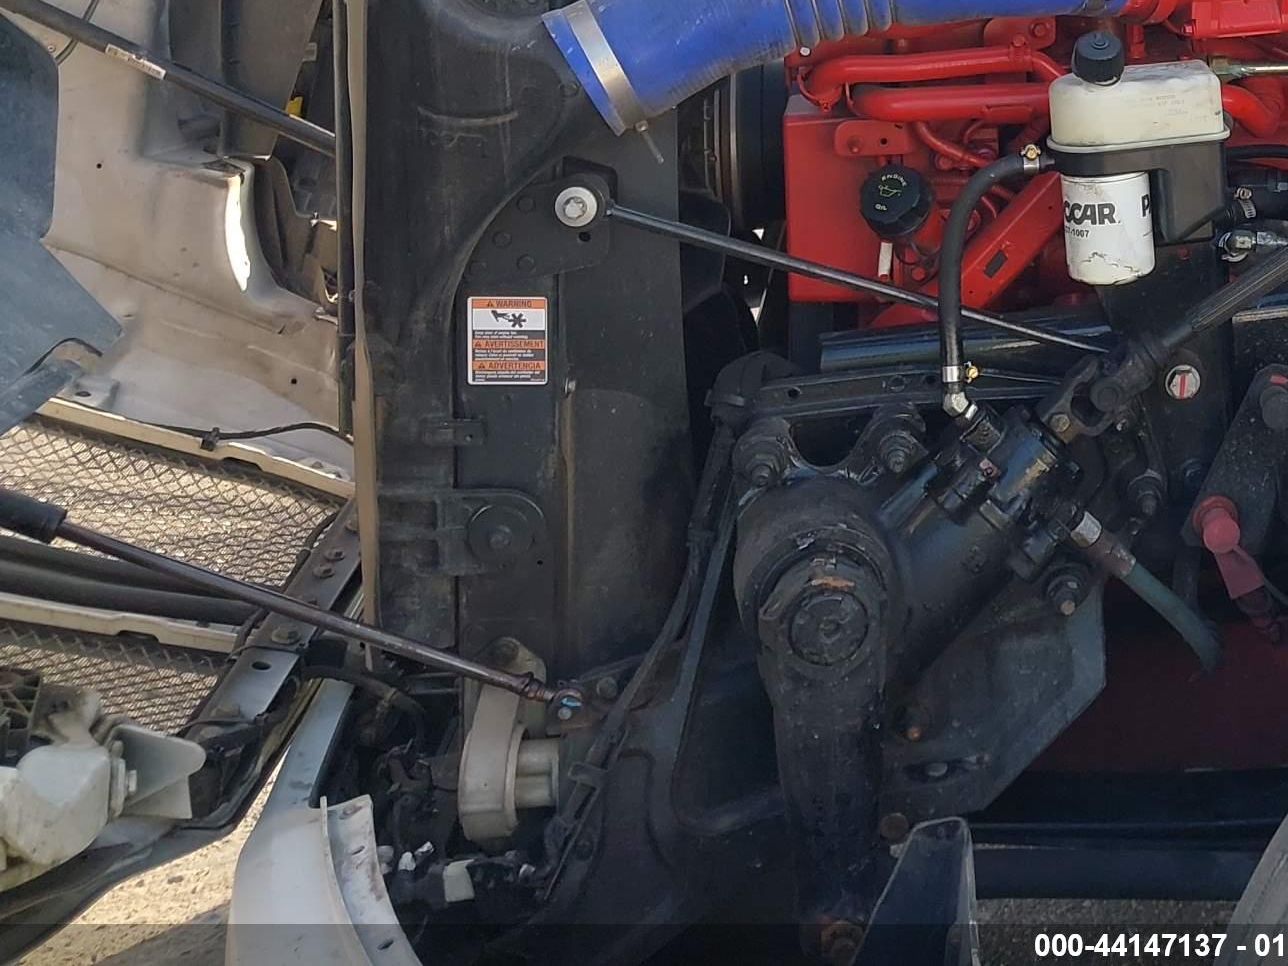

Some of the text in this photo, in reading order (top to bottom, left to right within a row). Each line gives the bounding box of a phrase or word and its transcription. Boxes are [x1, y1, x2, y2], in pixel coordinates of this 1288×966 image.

[881, 173, 908, 187] ENGINE
[874, 203, 888, 211] OIL
[496, 300, 532, 308] WARNING
[485, 340, 543, 348] AVERTISSEMENT
[488, 362, 541, 370] ADVERTENCIA
